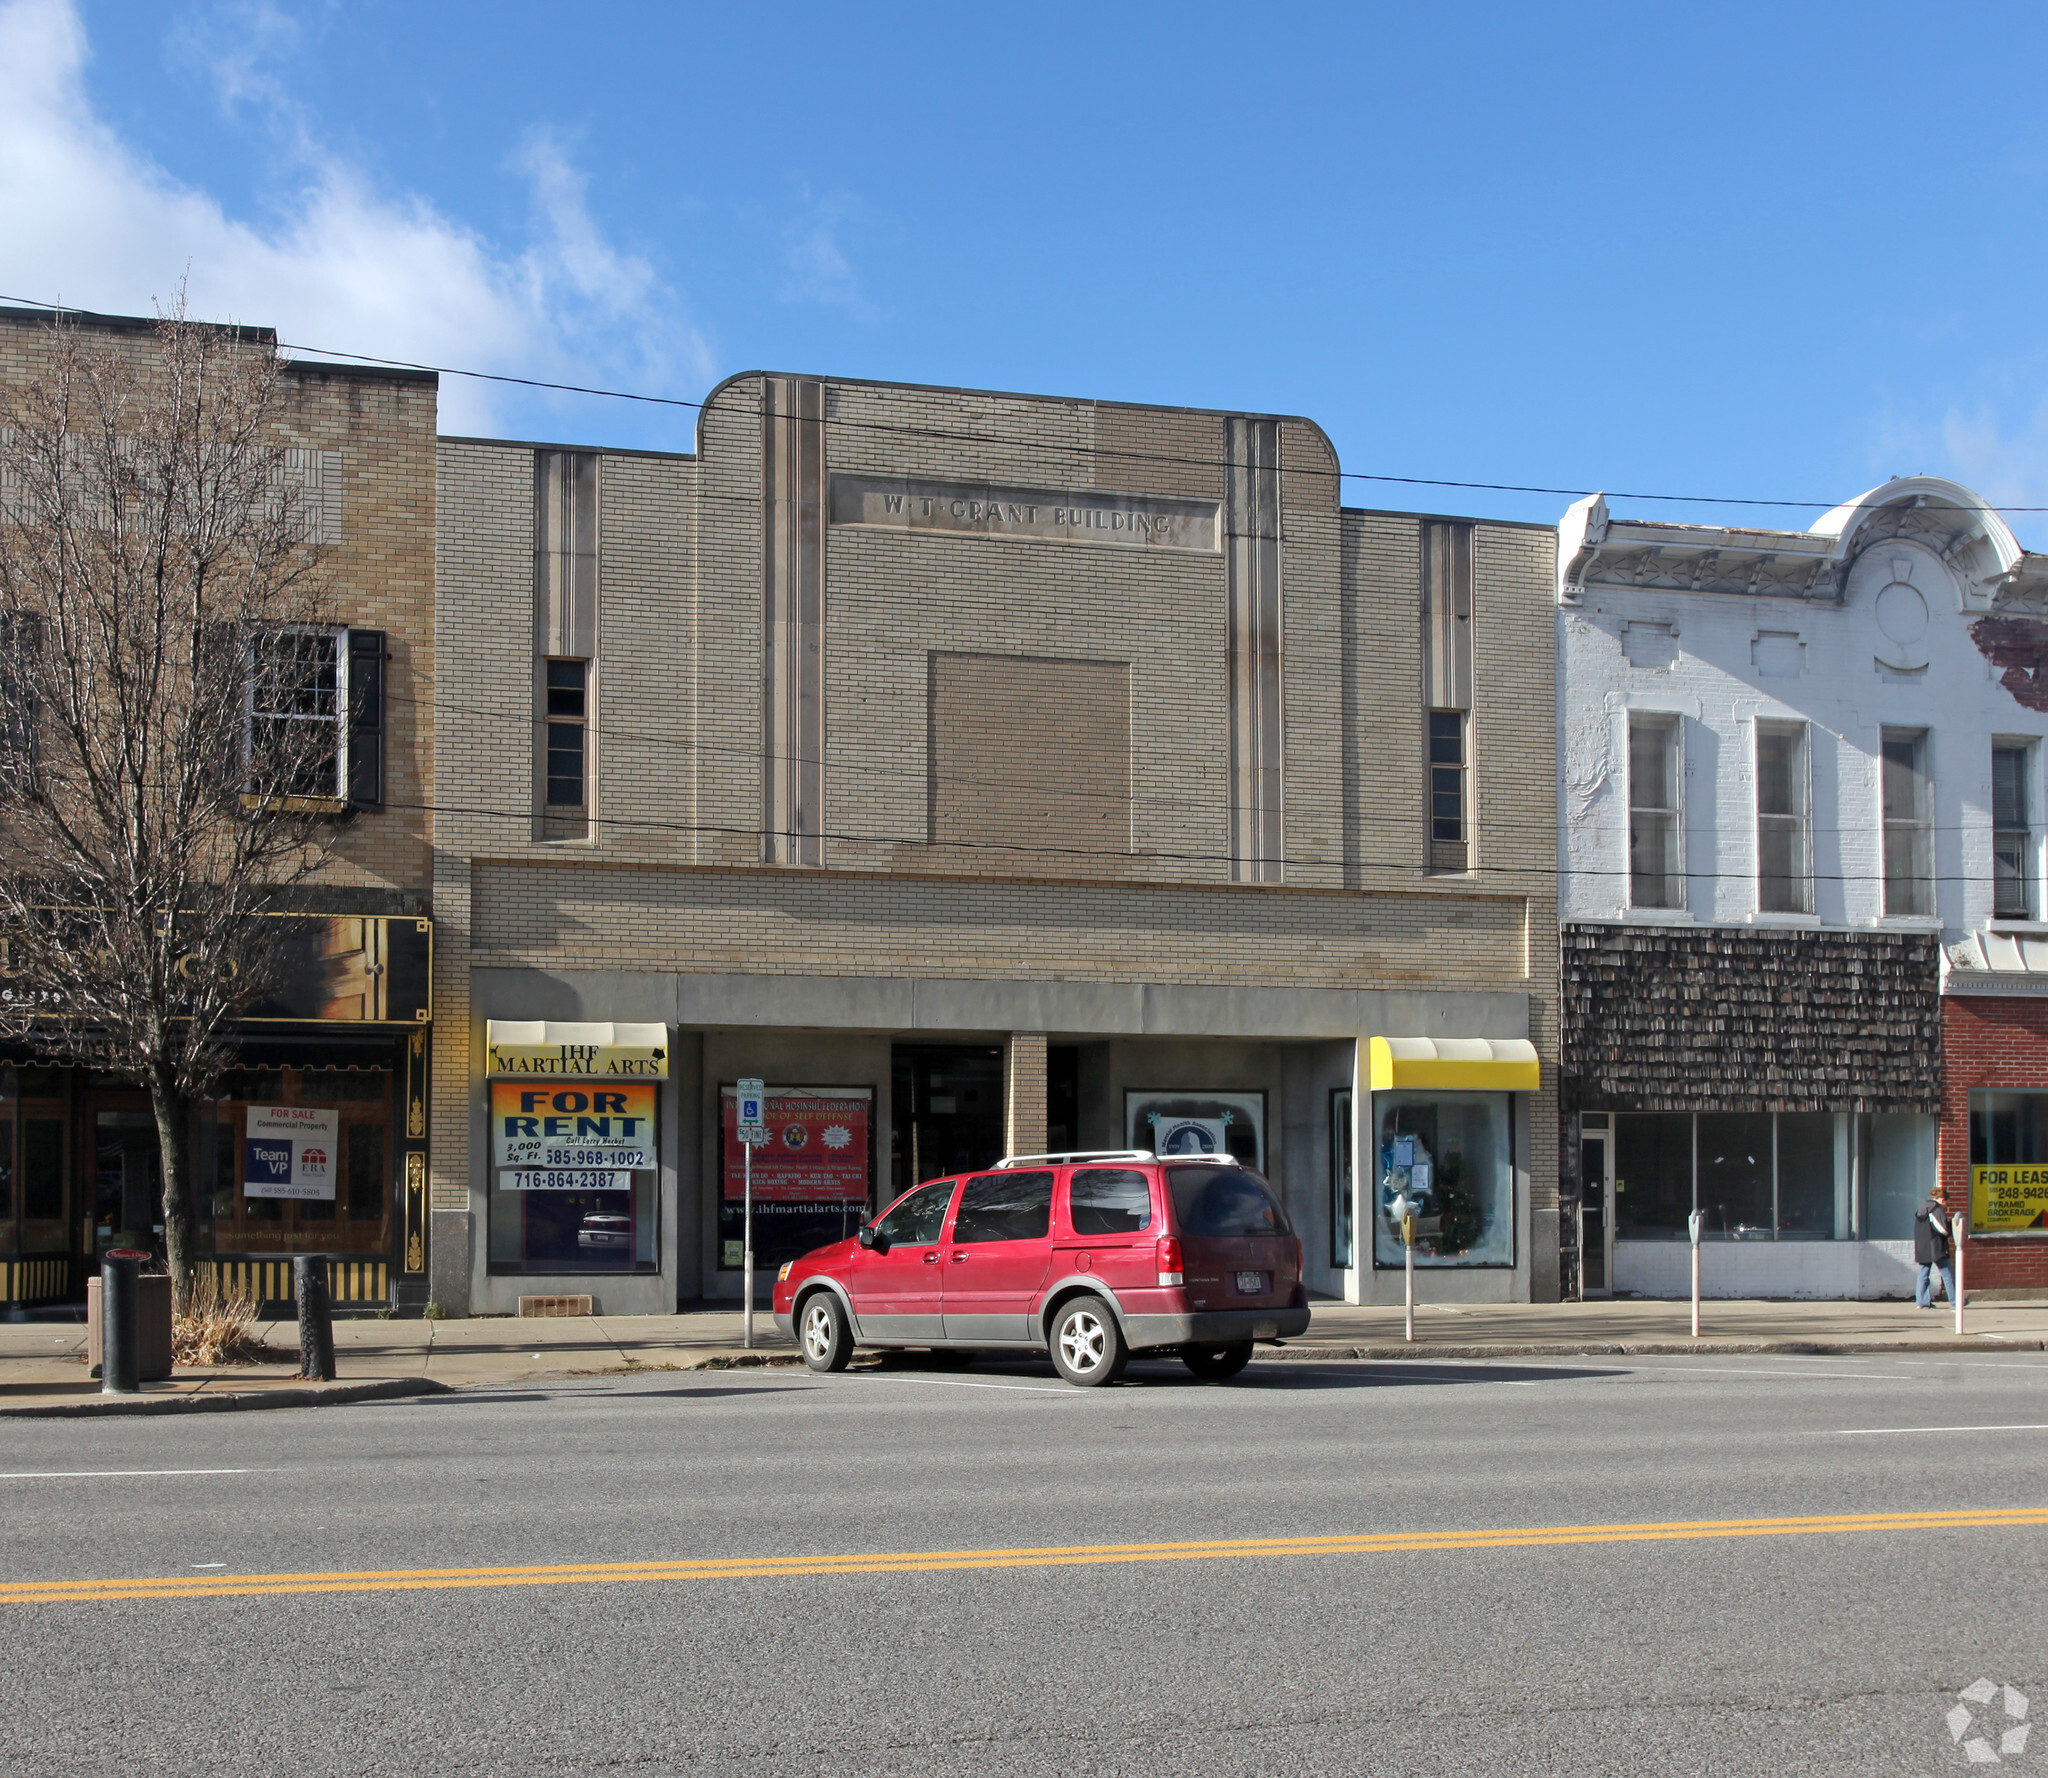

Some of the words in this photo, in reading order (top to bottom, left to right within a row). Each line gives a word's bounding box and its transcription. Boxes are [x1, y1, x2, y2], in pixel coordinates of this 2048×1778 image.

[950, 500, 1038, 524] GRANT
[1055, 507, 1170, 533] BUILDING
[560, 1045, 599, 1059] IHF
[497, 1057, 598, 1074] MARTIAL
[606, 1059, 659, 1075] ARTS
[521, 1092, 628, 1113] FOR
[786, 1102, 820, 1111] HOSINSUL
[823, 1102, 866, 1112] FEDERATION
[271, 1109, 289, 1118] FOR
[292, 1110, 316, 1119] SALE
[780, 1112, 791, 1120] OF
[795, 1112, 814, 1121] SELF
[816, 1113, 853, 1121] DEFENSE
[257, 1120, 298, 1129] Commercial
[299, 1122, 328, 1131] Property
[505, 1116, 645, 1137] RENT
[751, 1130, 762, 1139] FINE
[566, 1136, 580, 1145] Call
[507, 1141, 541, 1152] 3,000
[253, 1147, 288, 1161] Team
[507, 1153, 523, 1162] Sq.
[527, 1152, 541, 1160] Ft.
[269, 1162, 288, 1174] VP
[302, 1164, 326, 1173] ERA
[1980, 1171, 2008, 1184] FOR
[726, 1203, 866, 1215] ww.ihfmartialarts.com
[1988, 1200, 2026, 1209] PYRAMID
[1987, 1208, 2036, 1216] BROKERAGE
